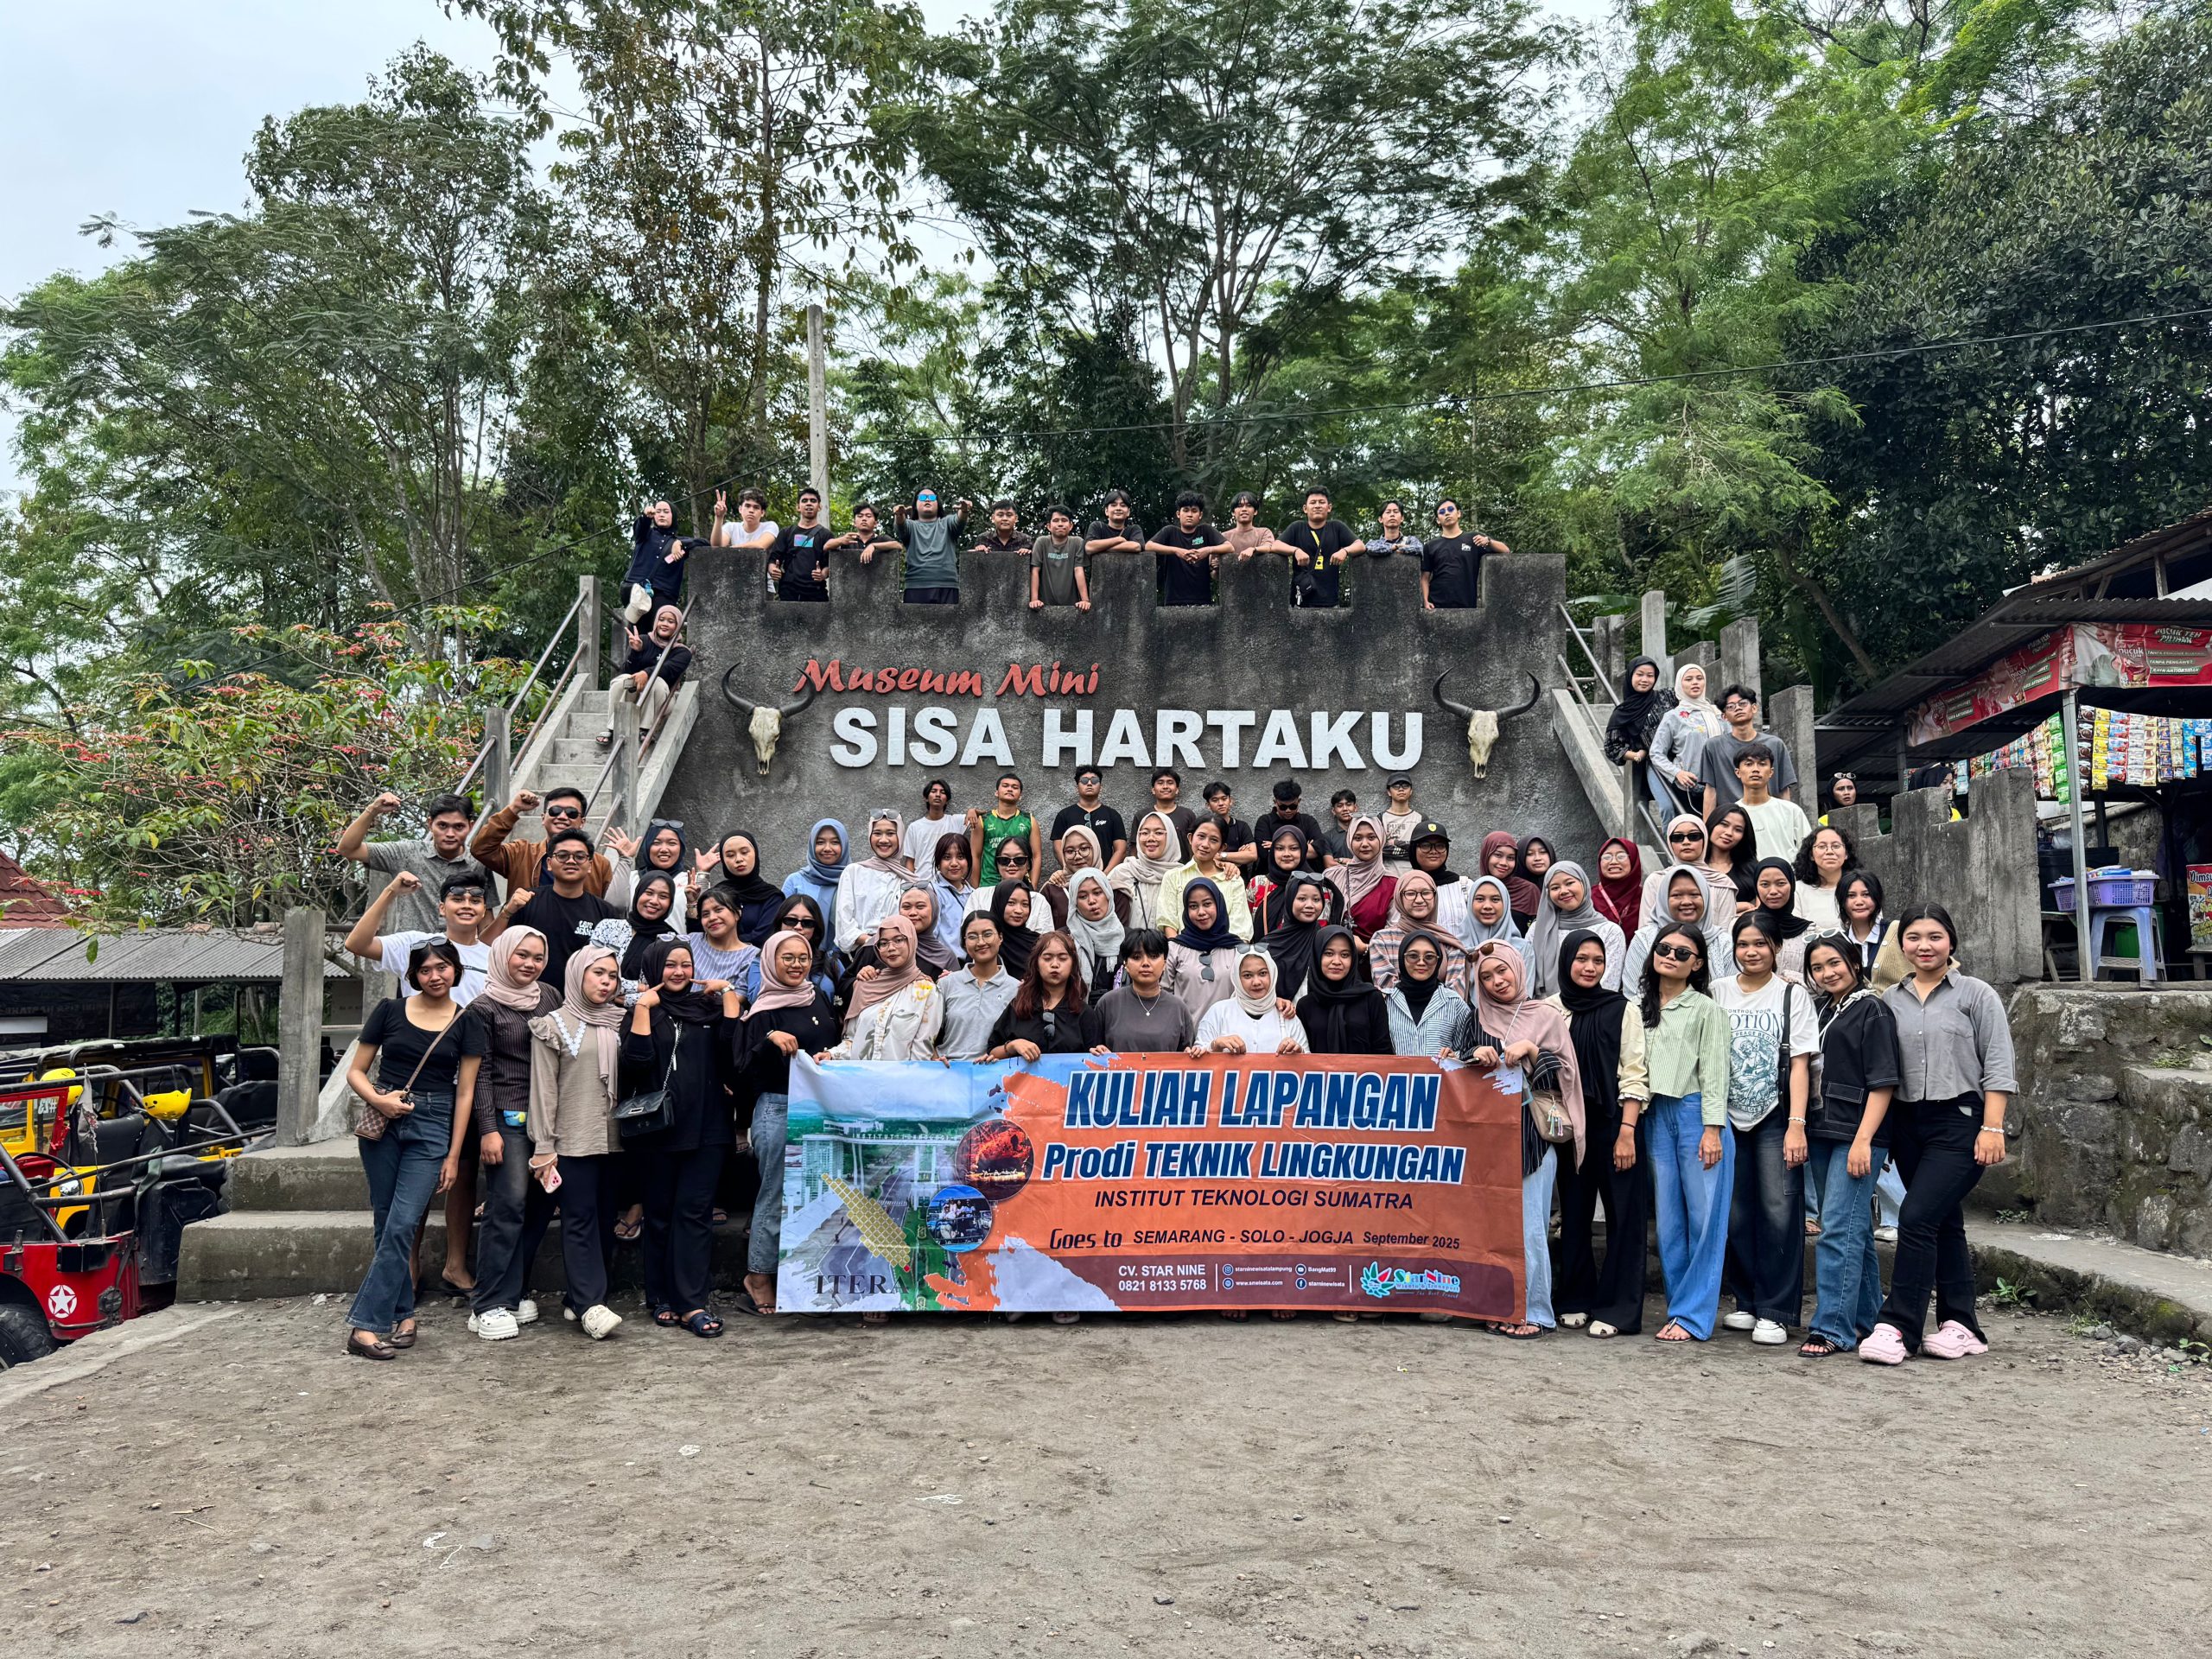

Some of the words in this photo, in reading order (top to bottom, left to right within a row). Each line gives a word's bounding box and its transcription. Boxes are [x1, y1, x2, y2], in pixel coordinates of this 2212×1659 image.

[793, 659, 982, 696] Museum
[995, 660, 1099, 697] Mini
[830, 707, 1014, 767] SISA
[1042, 709, 1423, 771] HARTAKU
[1728, 1013, 1785, 1042] OTION
[1064, 1070, 1213, 1128] KULIAH
[1218, 1070, 1441, 1132] LAPANGAN
[1040, 1140, 1138, 1180] Prodi
[1144, 1141, 1256, 1179] TEKNIK
[1258, 1141, 1466, 1185] LINGKUNGAN
[1095, 1190, 1185, 1207] INSTITUT
[1192, 1189, 1308, 1206] TEKNOLOGI
[1313, 1191, 1414, 1209] SUMATRA
[1050, 1228, 1096, 1249] Goes
[1103, 1230, 1122, 1248] to
[1134, 1230, 1225, 1244] SEMARANG
[1240, 1230, 1285, 1243] SOLO
[1299, 1230, 1354, 1244] JOGJA
[1363, 1231, 1429, 1246] September
[1432, 1236, 1460, 1249] 2025
[1118, 1265, 1138, 1276] CV.
[1141, 1265, 1174, 1276] STAR
[1177, 1264, 1206, 1275] NINE
[817, 1274, 910, 1294] ITERA
[1118, 1280, 1146, 1291] 0821
[1149, 1280, 1177, 1291] 8133
[1179, 1279, 1207, 1290] 5768
